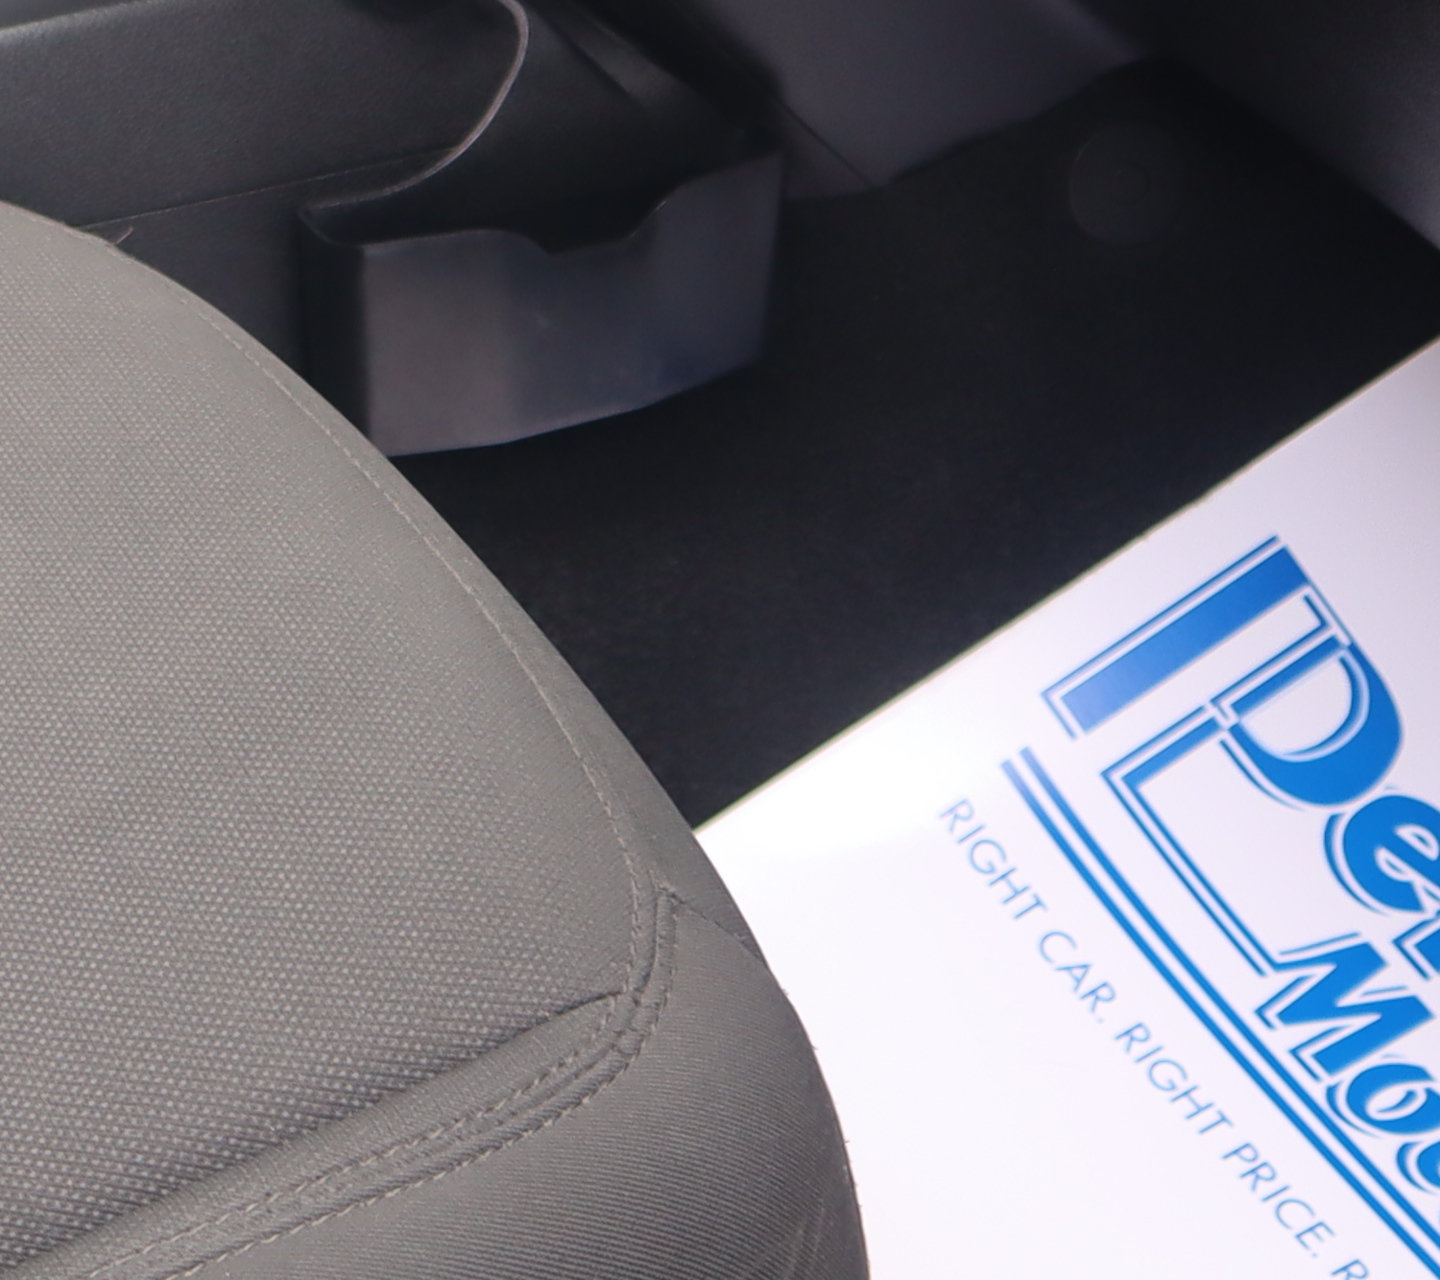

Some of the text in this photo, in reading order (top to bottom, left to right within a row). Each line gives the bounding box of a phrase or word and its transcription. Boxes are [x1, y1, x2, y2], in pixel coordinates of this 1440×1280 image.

[939, 797, 1047, 921] RIGHT
[1037, 930, 1117, 1024] CAR.
[1114, 1021, 1235, 1136] RIGHT
[1221, 1142, 1336, 1259] PRICE.
